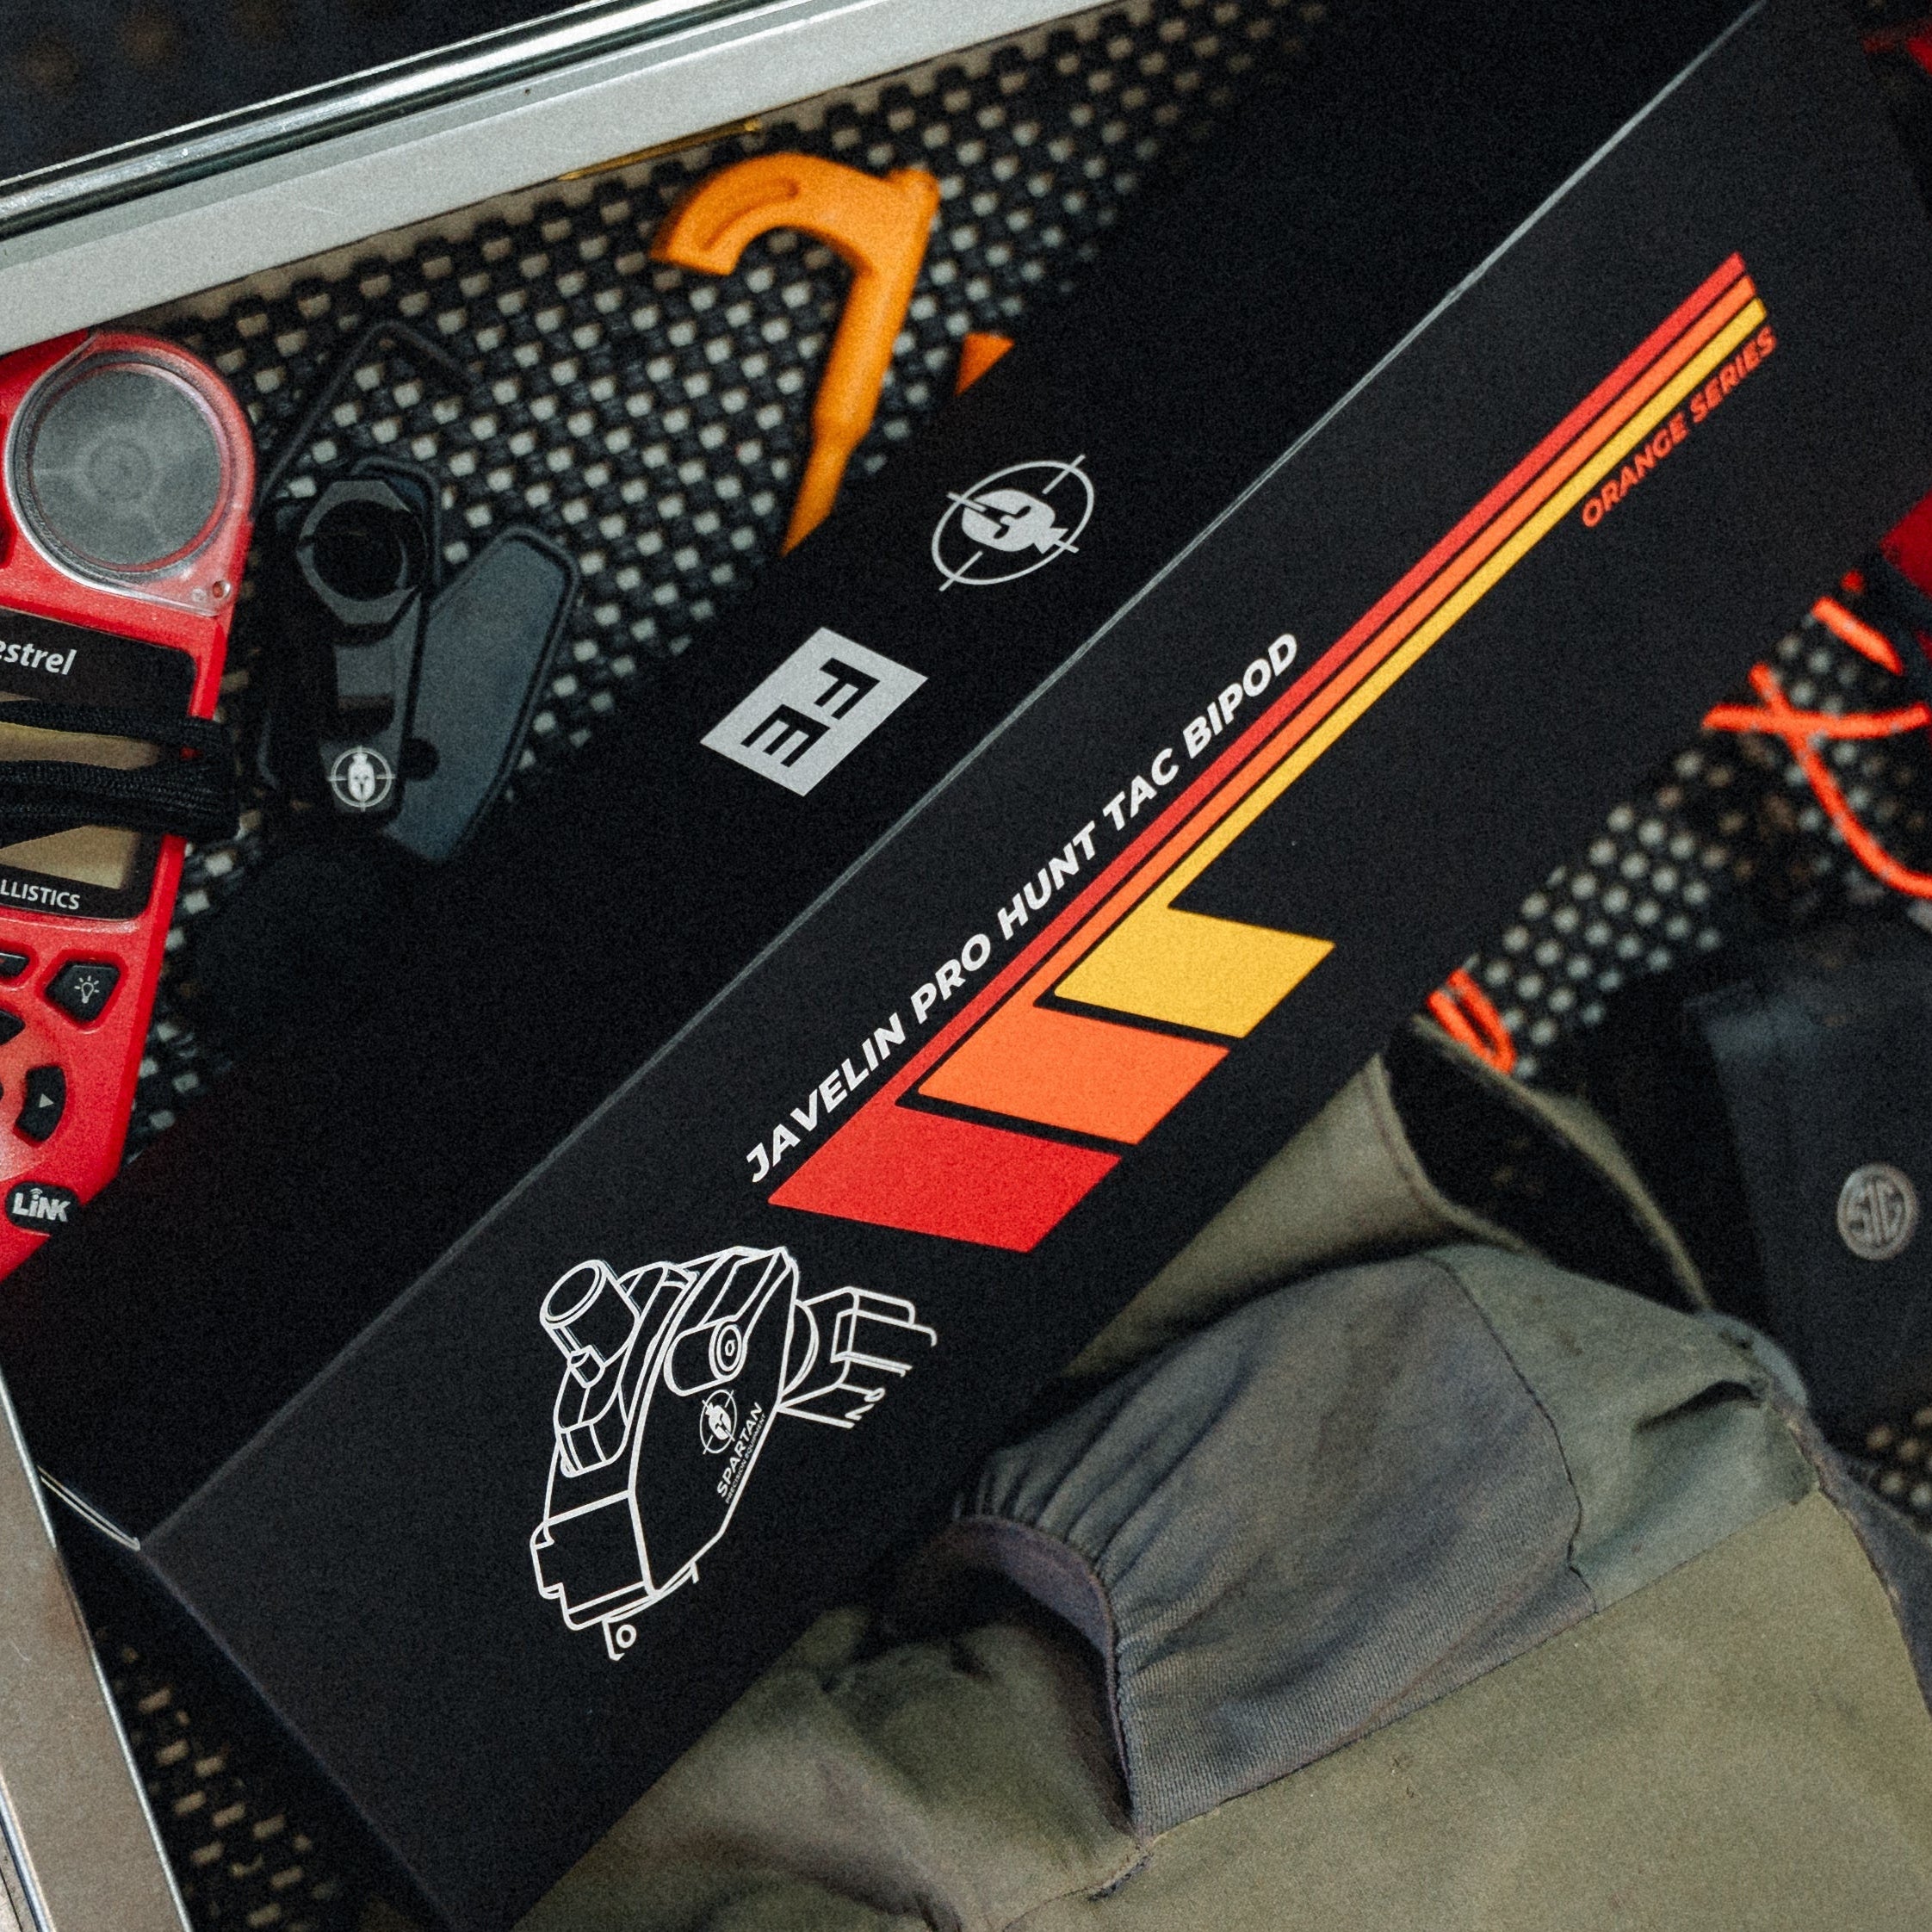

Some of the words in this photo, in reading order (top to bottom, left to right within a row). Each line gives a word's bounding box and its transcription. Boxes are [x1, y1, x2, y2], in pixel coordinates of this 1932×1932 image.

[1582, 412, 1689, 528] ORANGE
[1690, 325, 1776, 424] SERIES
[0, 879, 81, 910] LLISTICS
[746, 1012, 906, 1183] JAVELIN
[910, 933, 991, 1025] PRO
[997, 820, 1096, 941] HUNT
[1102, 747, 1180, 831] TAC
[1182, 633, 1297, 759] BIPOD
[716, 1402, 763, 1498] SPARTAN
[725, 1458, 747, 1504] PRECISION
